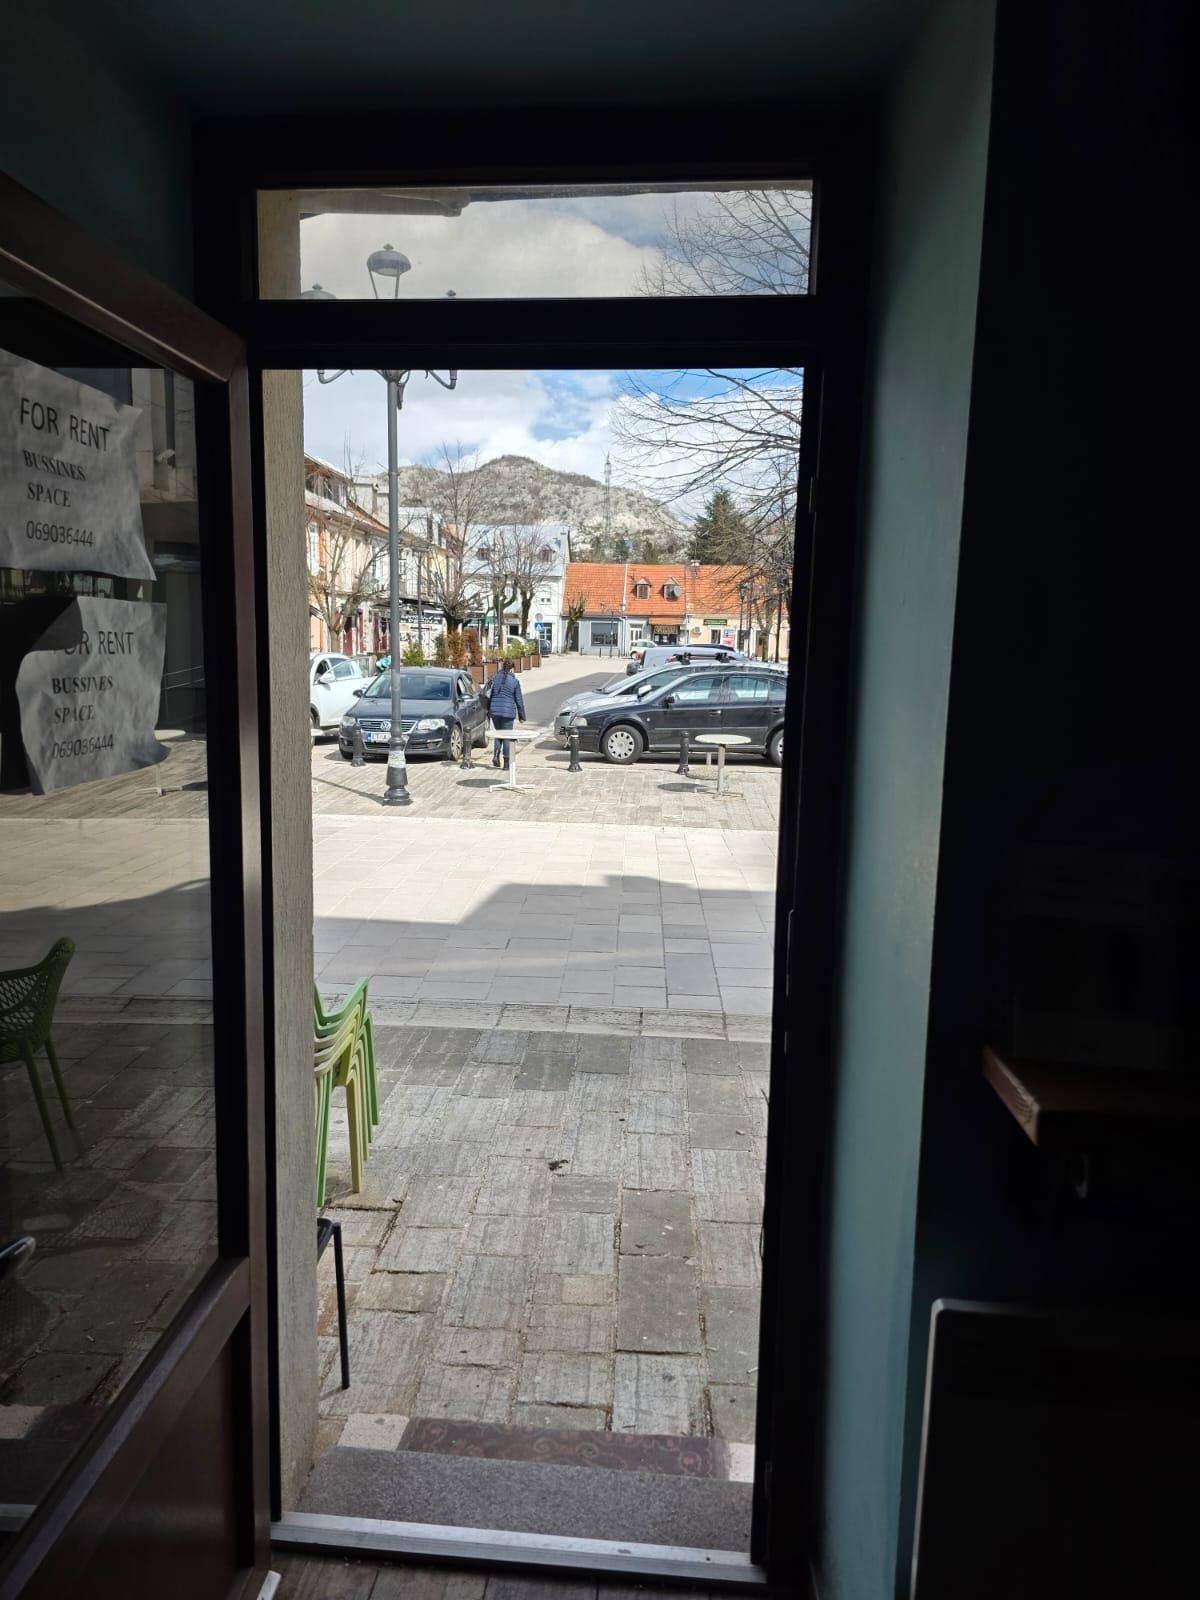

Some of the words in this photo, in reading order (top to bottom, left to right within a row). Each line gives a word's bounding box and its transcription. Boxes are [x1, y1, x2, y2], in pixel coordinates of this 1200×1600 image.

[20, 398, 59, 435] FOR
[70, 415, 110, 451] RENT
[23, 450, 86, 481] BUSSINES
[27, 482, 71, 507] SPACE
[26, 521, 94, 546] 069036444
[98, 631, 134, 655] RENT
[52, 675, 113, 694] BUSSINES
[54, 705, 96, 724] SPACE
[52, 734, 114, 759] 069036444
